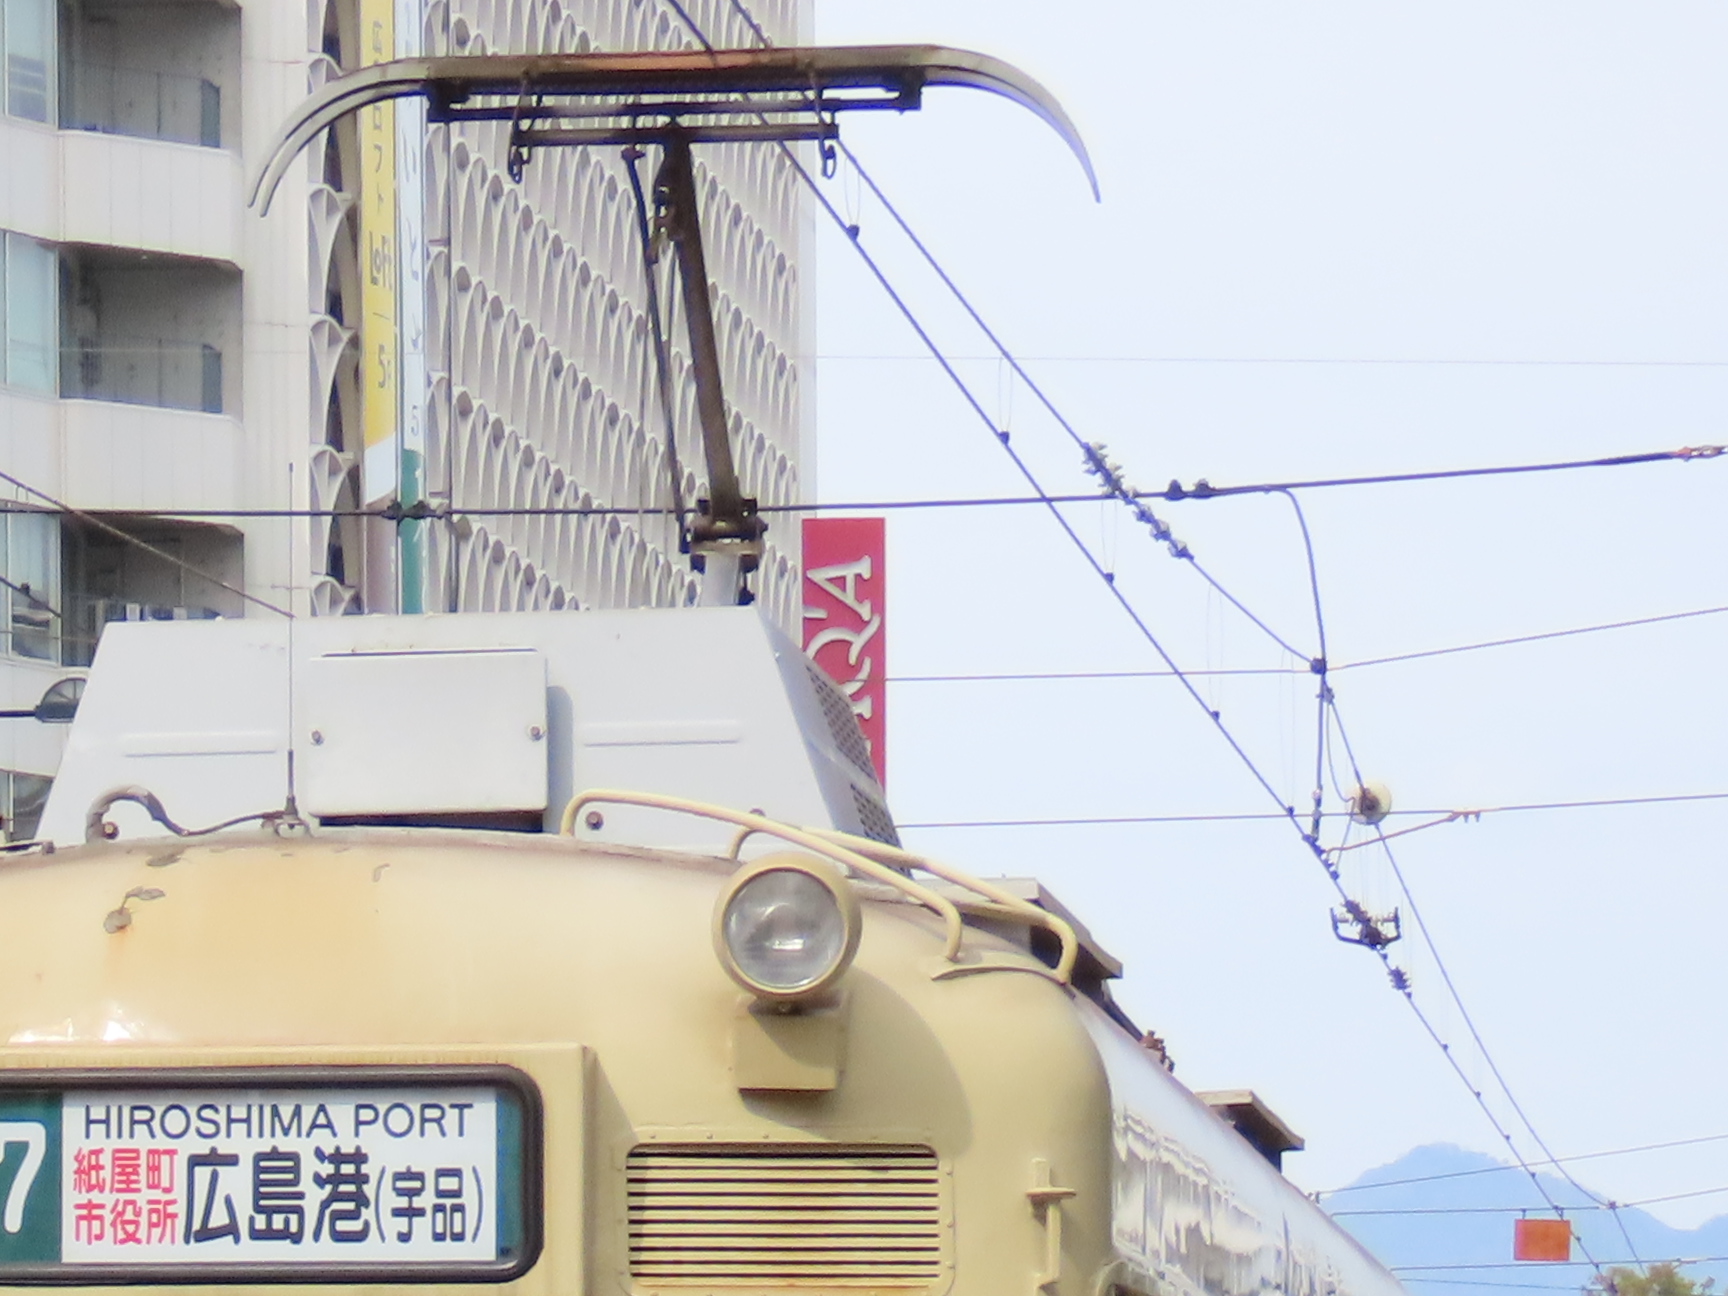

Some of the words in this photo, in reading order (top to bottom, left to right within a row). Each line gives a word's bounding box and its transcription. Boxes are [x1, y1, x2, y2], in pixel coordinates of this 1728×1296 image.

[84, 1102, 338, 1140] HIROSHIMA
[353, 1102, 474, 1140] PORT
[72, 1145, 180, 1195] 紙屋町
[72, 1197, 180, 1247] 市役所
